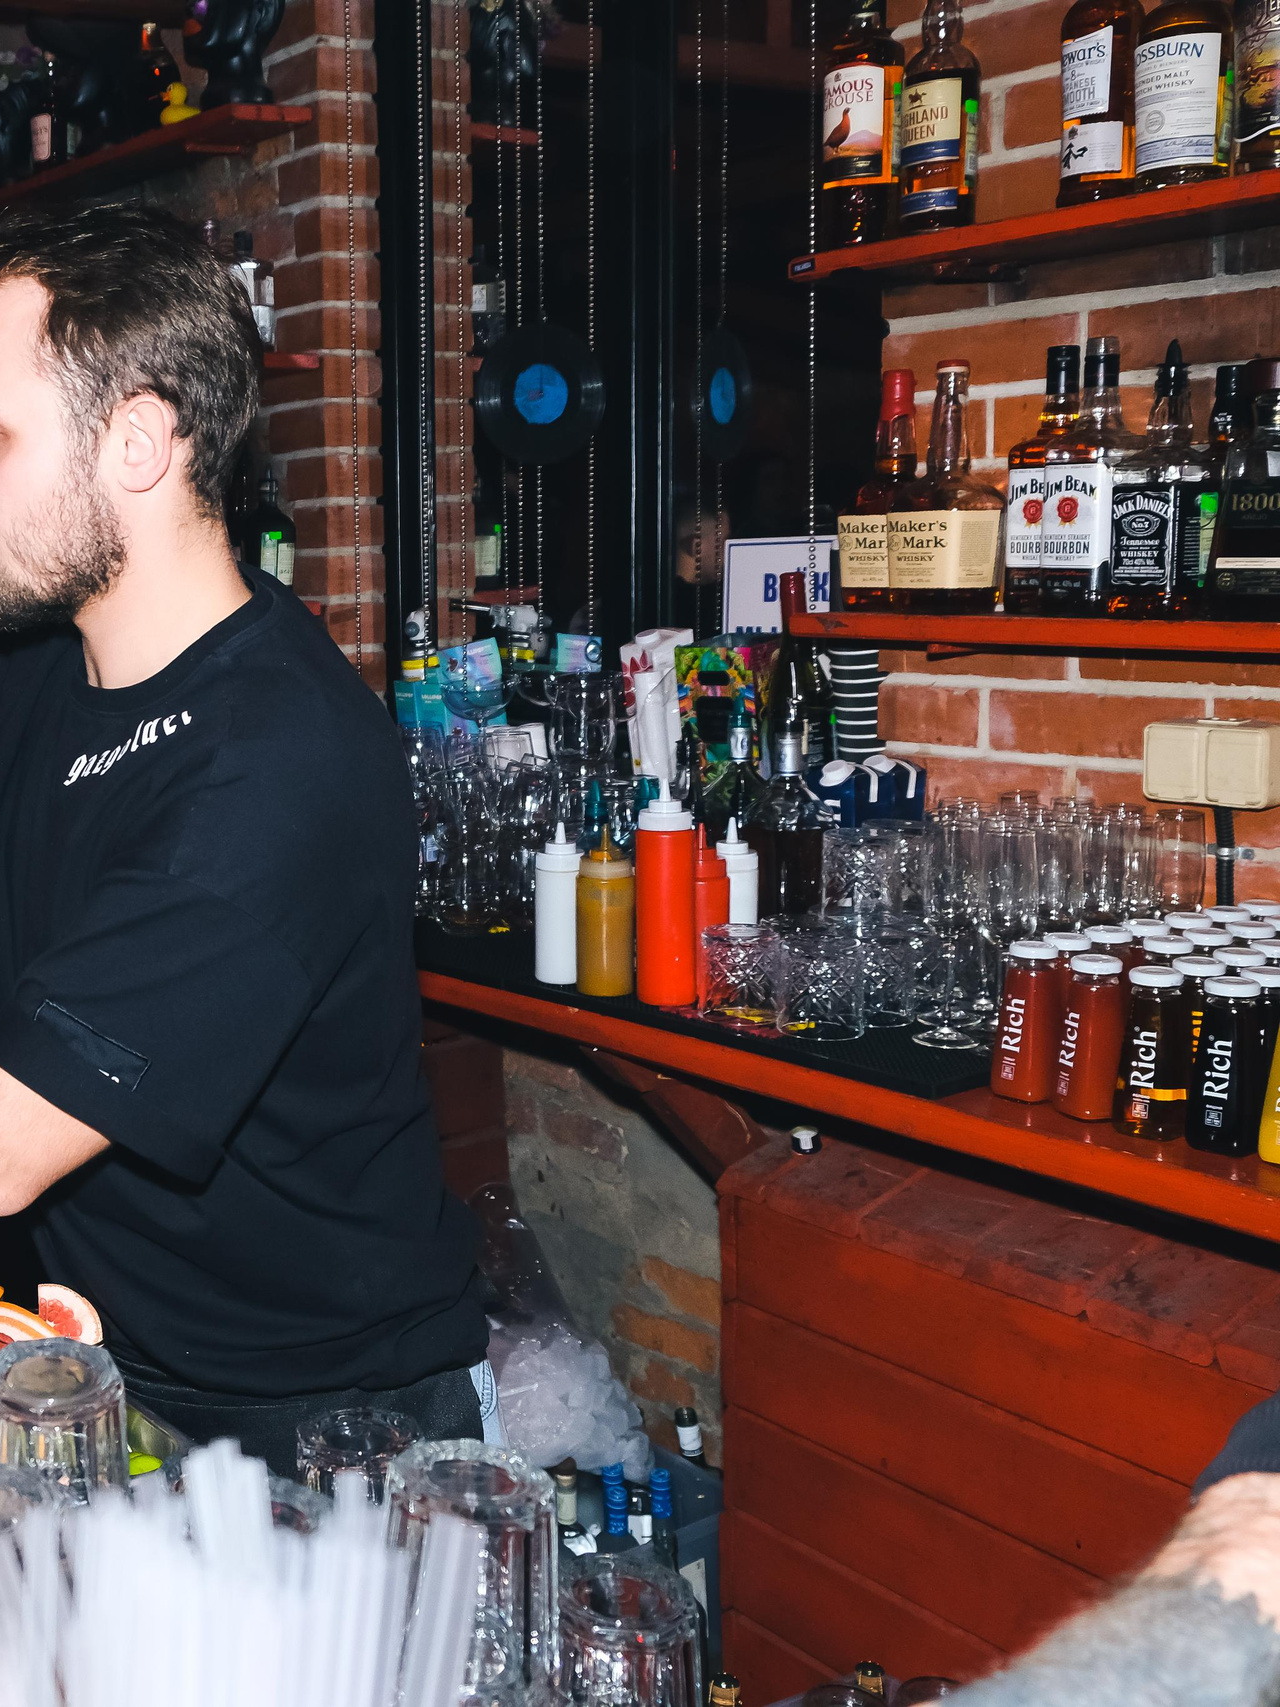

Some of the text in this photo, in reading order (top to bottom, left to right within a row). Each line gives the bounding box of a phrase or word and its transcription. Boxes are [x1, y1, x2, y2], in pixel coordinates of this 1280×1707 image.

[1135, 42, 1205, 67] OSSBURN
[1164, 70, 1191, 79] MALT
[1155, 78, 1195, 90] WHISKY
[1009, 478, 1045, 505] JIM BE
[1043, 475, 1098, 504] JIM BEAM
[1231, 492, 1280, 512] 1800
[1113, 499, 1135, 520] JACK
[840, 522, 887, 534] Maker
[888, 520, 947, 533] Maker's
[855, 537, 888, 549] Mar
[902, 536, 946, 549] Mark
[1010, 541, 1040, 554] BOURB
[1043, 541, 1090, 554] BOURBON
[1120, 536, 1160, 546] Tennessee
[1120, 550, 1160, 558] WHISKEY
[1001, 998, 1026, 1053] Rich
[1059, 1011, 1080, 1068] Rich
[1130, 1030, 1158, 1089] Rich
[1203, 1040, 1233, 1100] Rich
